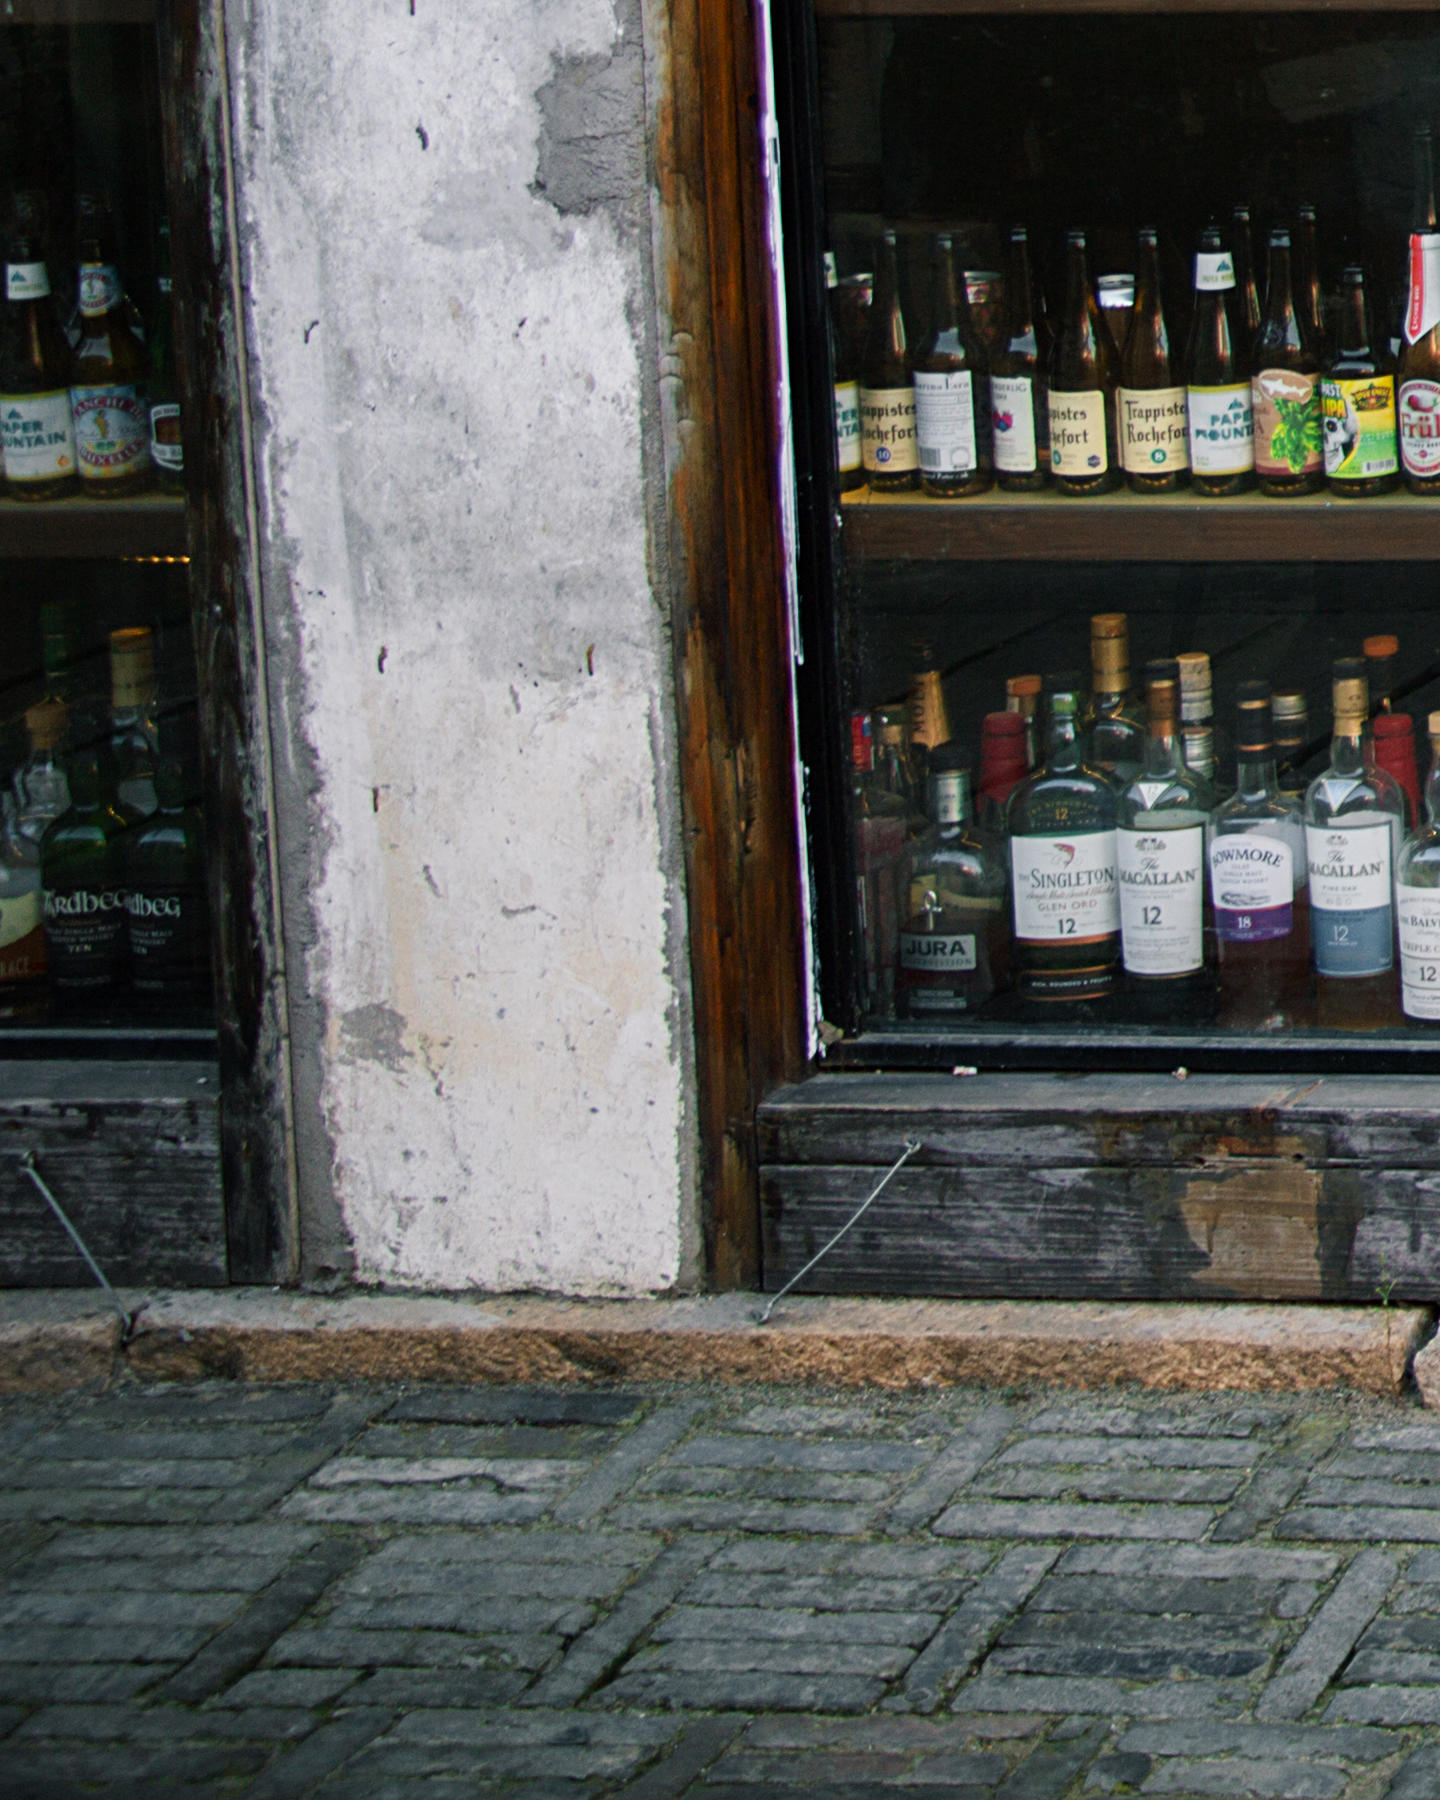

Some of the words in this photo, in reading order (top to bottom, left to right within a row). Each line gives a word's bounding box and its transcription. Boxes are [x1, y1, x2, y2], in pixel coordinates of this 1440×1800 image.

[1125, 400, 1186, 419] Trappiste
[1127, 423, 1187, 445] Rochefor
[1212, 848, 1284, 869] BOWMORE
[1031, 866, 1115, 888] SINGLETON
[1120, 868, 1198, 886] MACALLAN
[1308, 861, 1385, 878] MACALLAN
[1038, 901, 1067, 912] GLEN
[1071, 898, 1098, 909] ORD
[1141, 905, 1162, 925] 12
[1237, 916, 1251, 930] 18
[1058, 917, 1078, 934] 12
[1334, 925, 1349, 942] 12
[905, 940, 966, 956] JURA
[1419, 966, 1438, 982] 12
